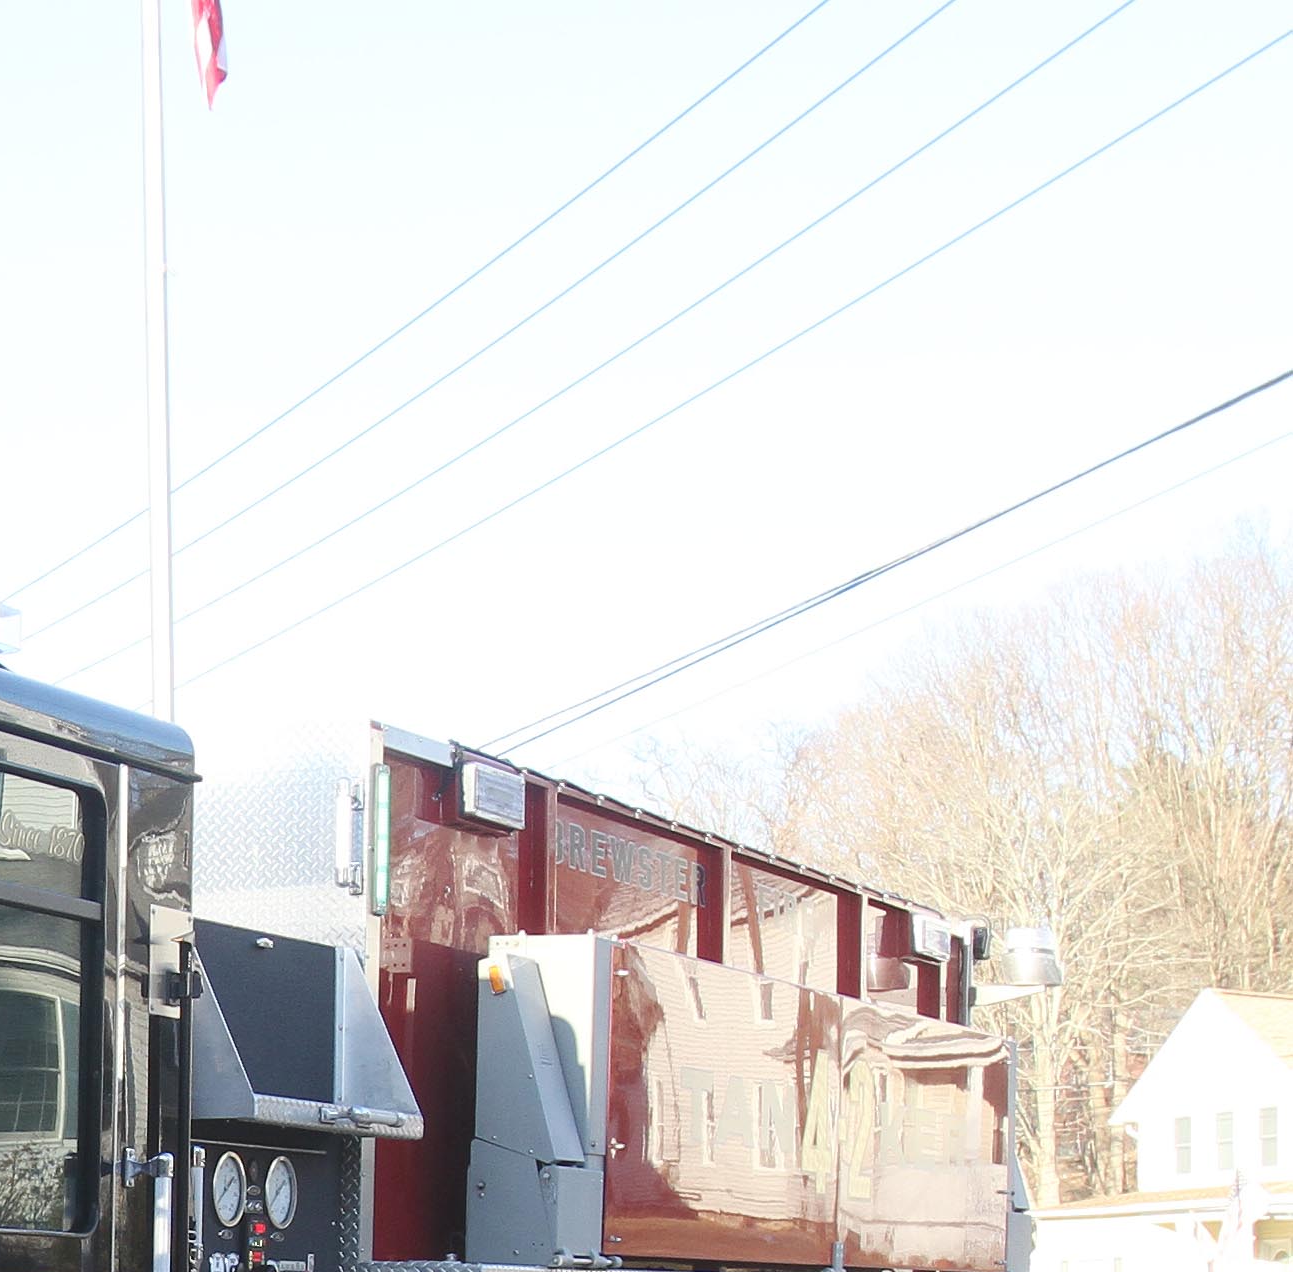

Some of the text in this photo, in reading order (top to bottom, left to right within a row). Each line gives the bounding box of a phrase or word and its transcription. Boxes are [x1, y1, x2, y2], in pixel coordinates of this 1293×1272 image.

[0, 808, 42, 850] Since
[48, 825, 85, 866] 1870
[801, 1048, 872, 1200] 4-2
